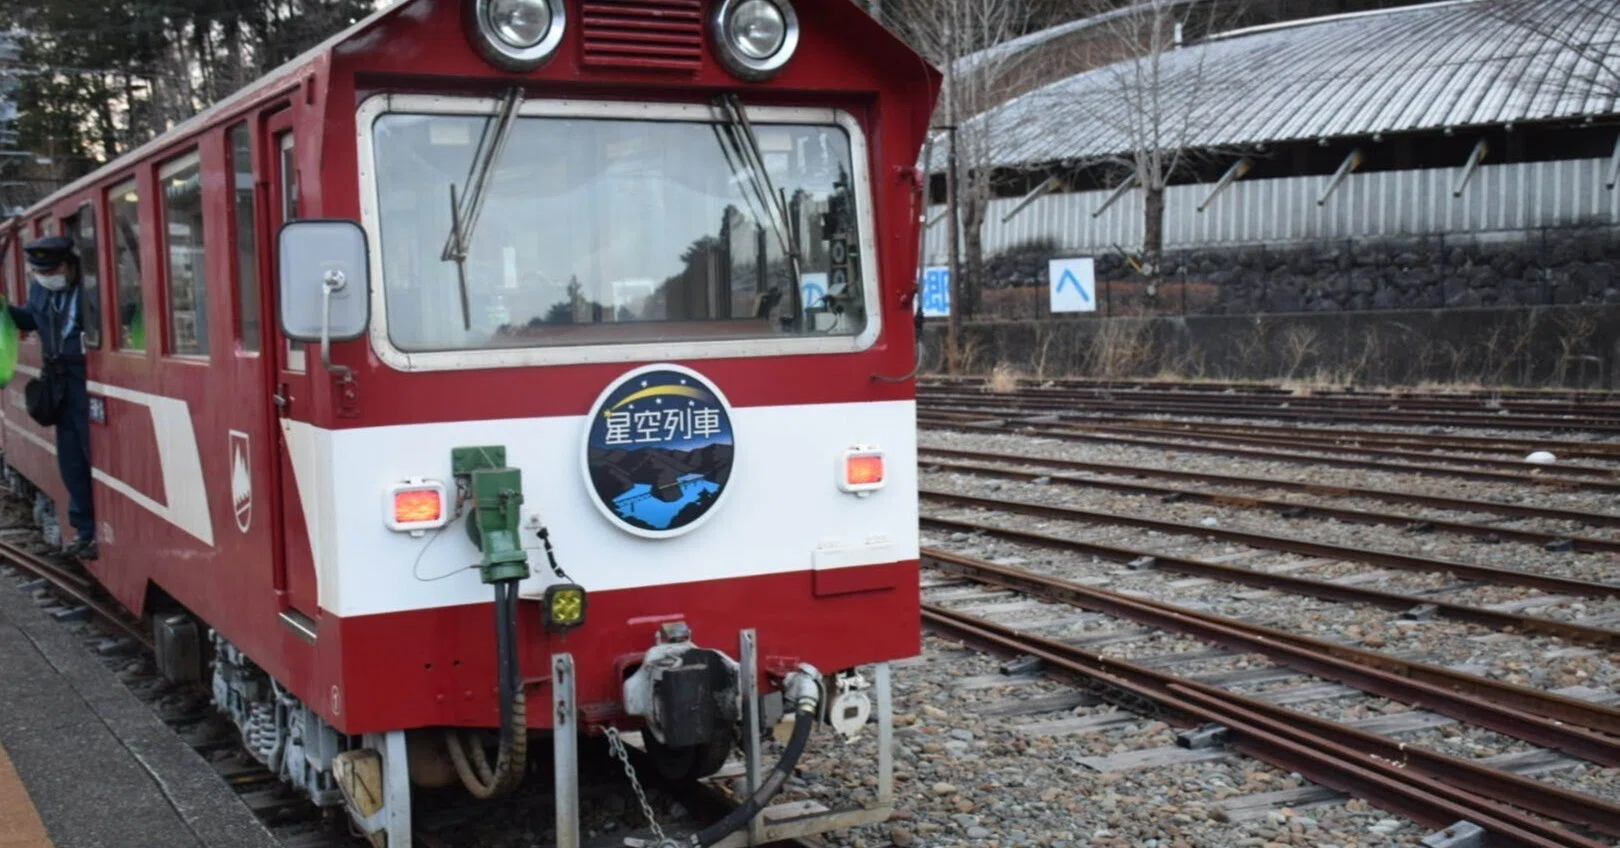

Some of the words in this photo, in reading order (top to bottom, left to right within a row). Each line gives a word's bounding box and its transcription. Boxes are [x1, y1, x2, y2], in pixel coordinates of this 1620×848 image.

[1056, 267, 1089, 302] へ
[604, 407, 721, 445] 星空列車
